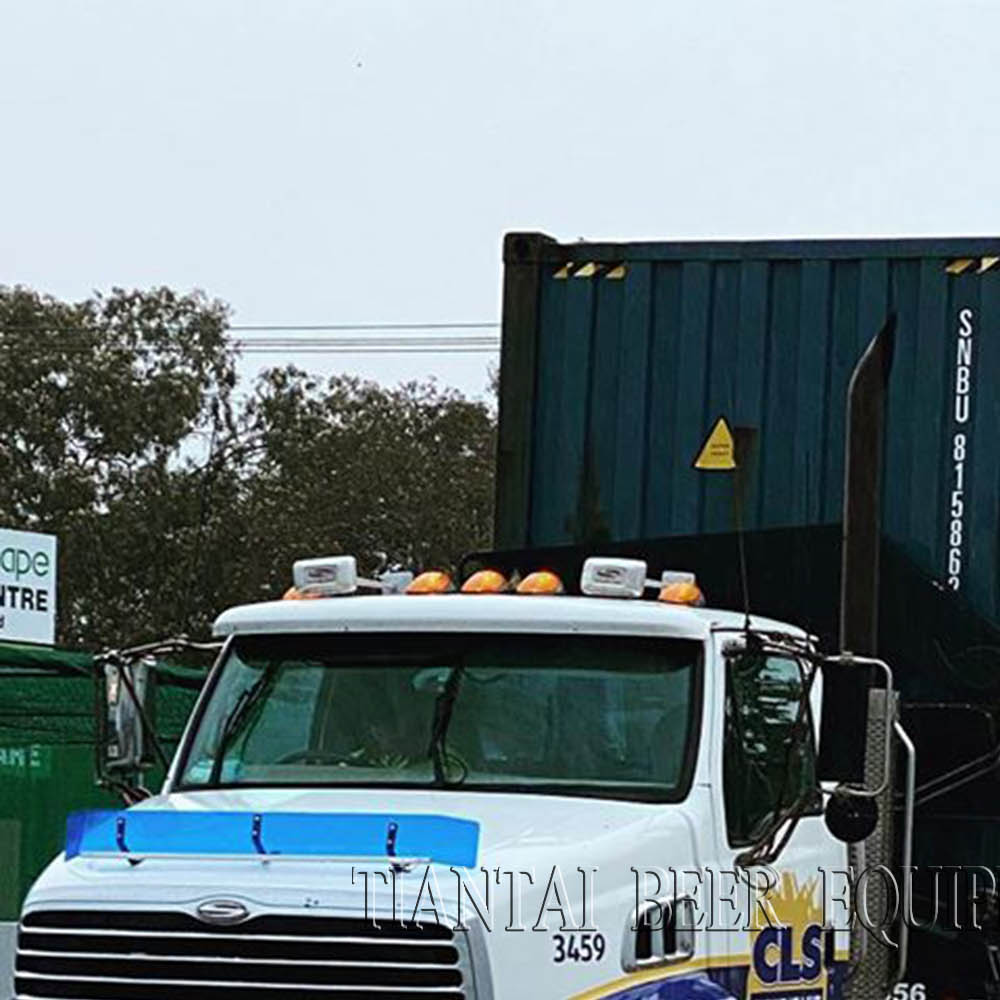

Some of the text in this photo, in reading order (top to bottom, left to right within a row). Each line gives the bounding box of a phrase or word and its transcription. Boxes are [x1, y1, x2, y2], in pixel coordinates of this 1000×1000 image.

[954, 308, 973, 423] SNBU
[552, 933, 606, 963] 3459
[752, 923, 824, 984] CLS
